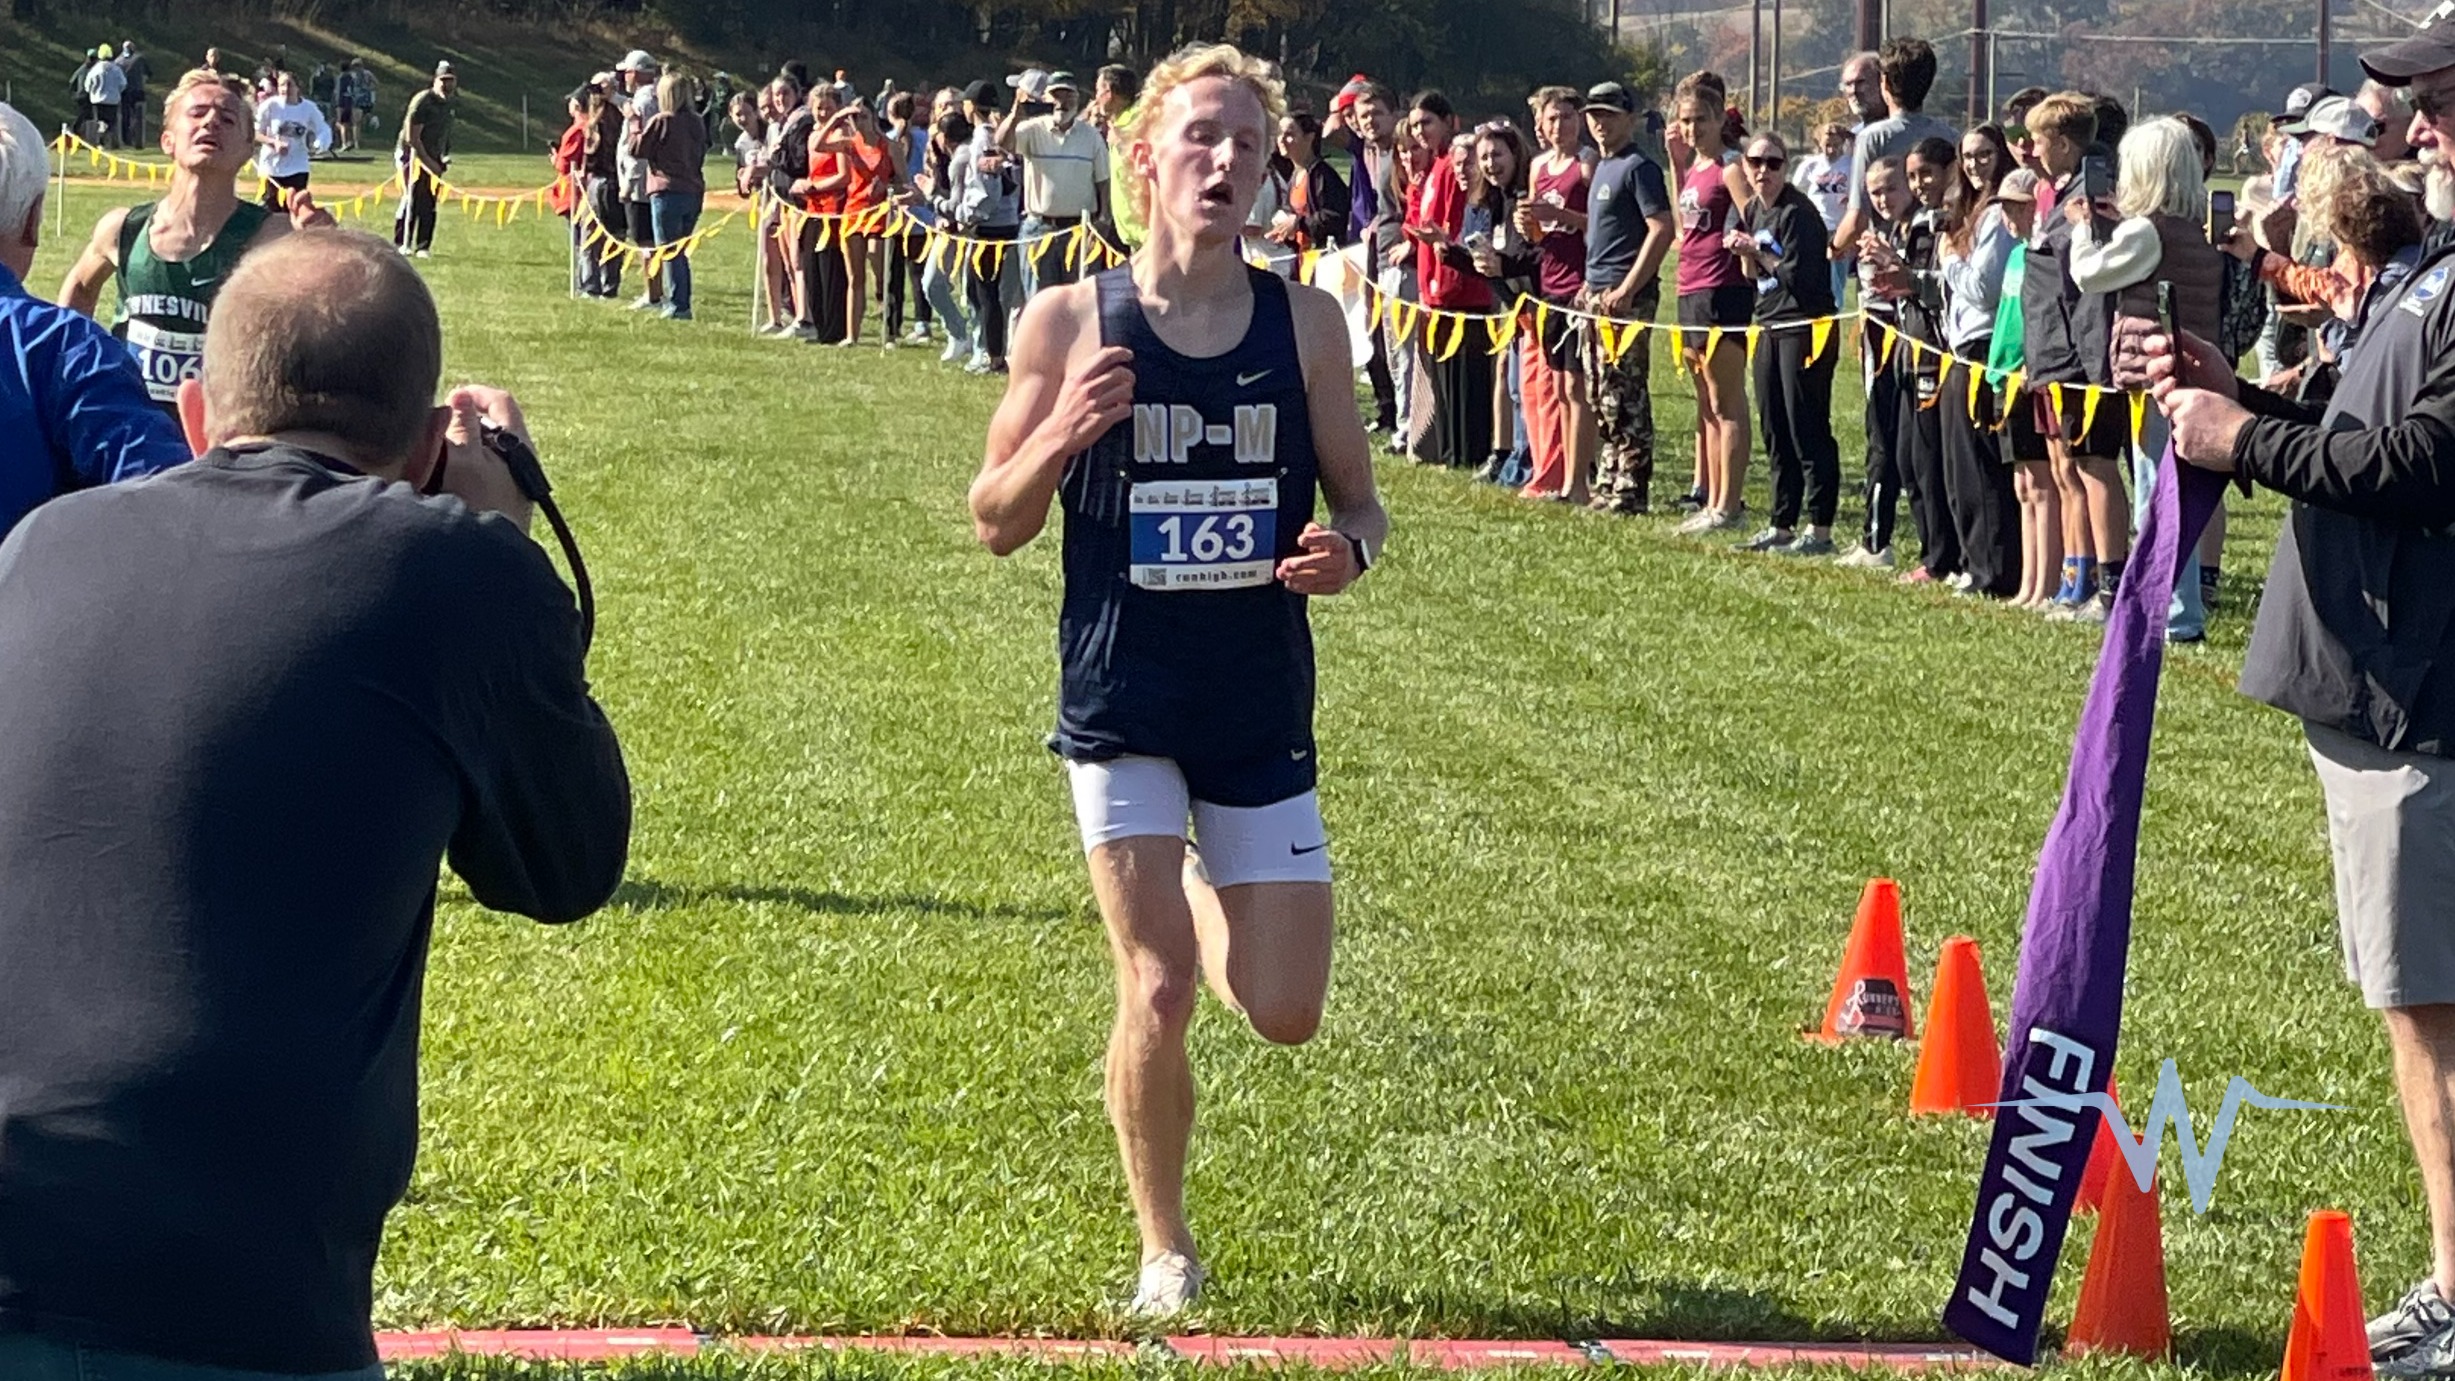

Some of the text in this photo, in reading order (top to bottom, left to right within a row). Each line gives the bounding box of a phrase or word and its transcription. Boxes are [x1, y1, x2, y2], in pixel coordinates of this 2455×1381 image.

[138, 350, 204, 384] 106
[1133, 403, 1277, 463] NP-M
[1158, 513, 1255, 562] 163
[1967, 1027, 2096, 1330] FINISH
